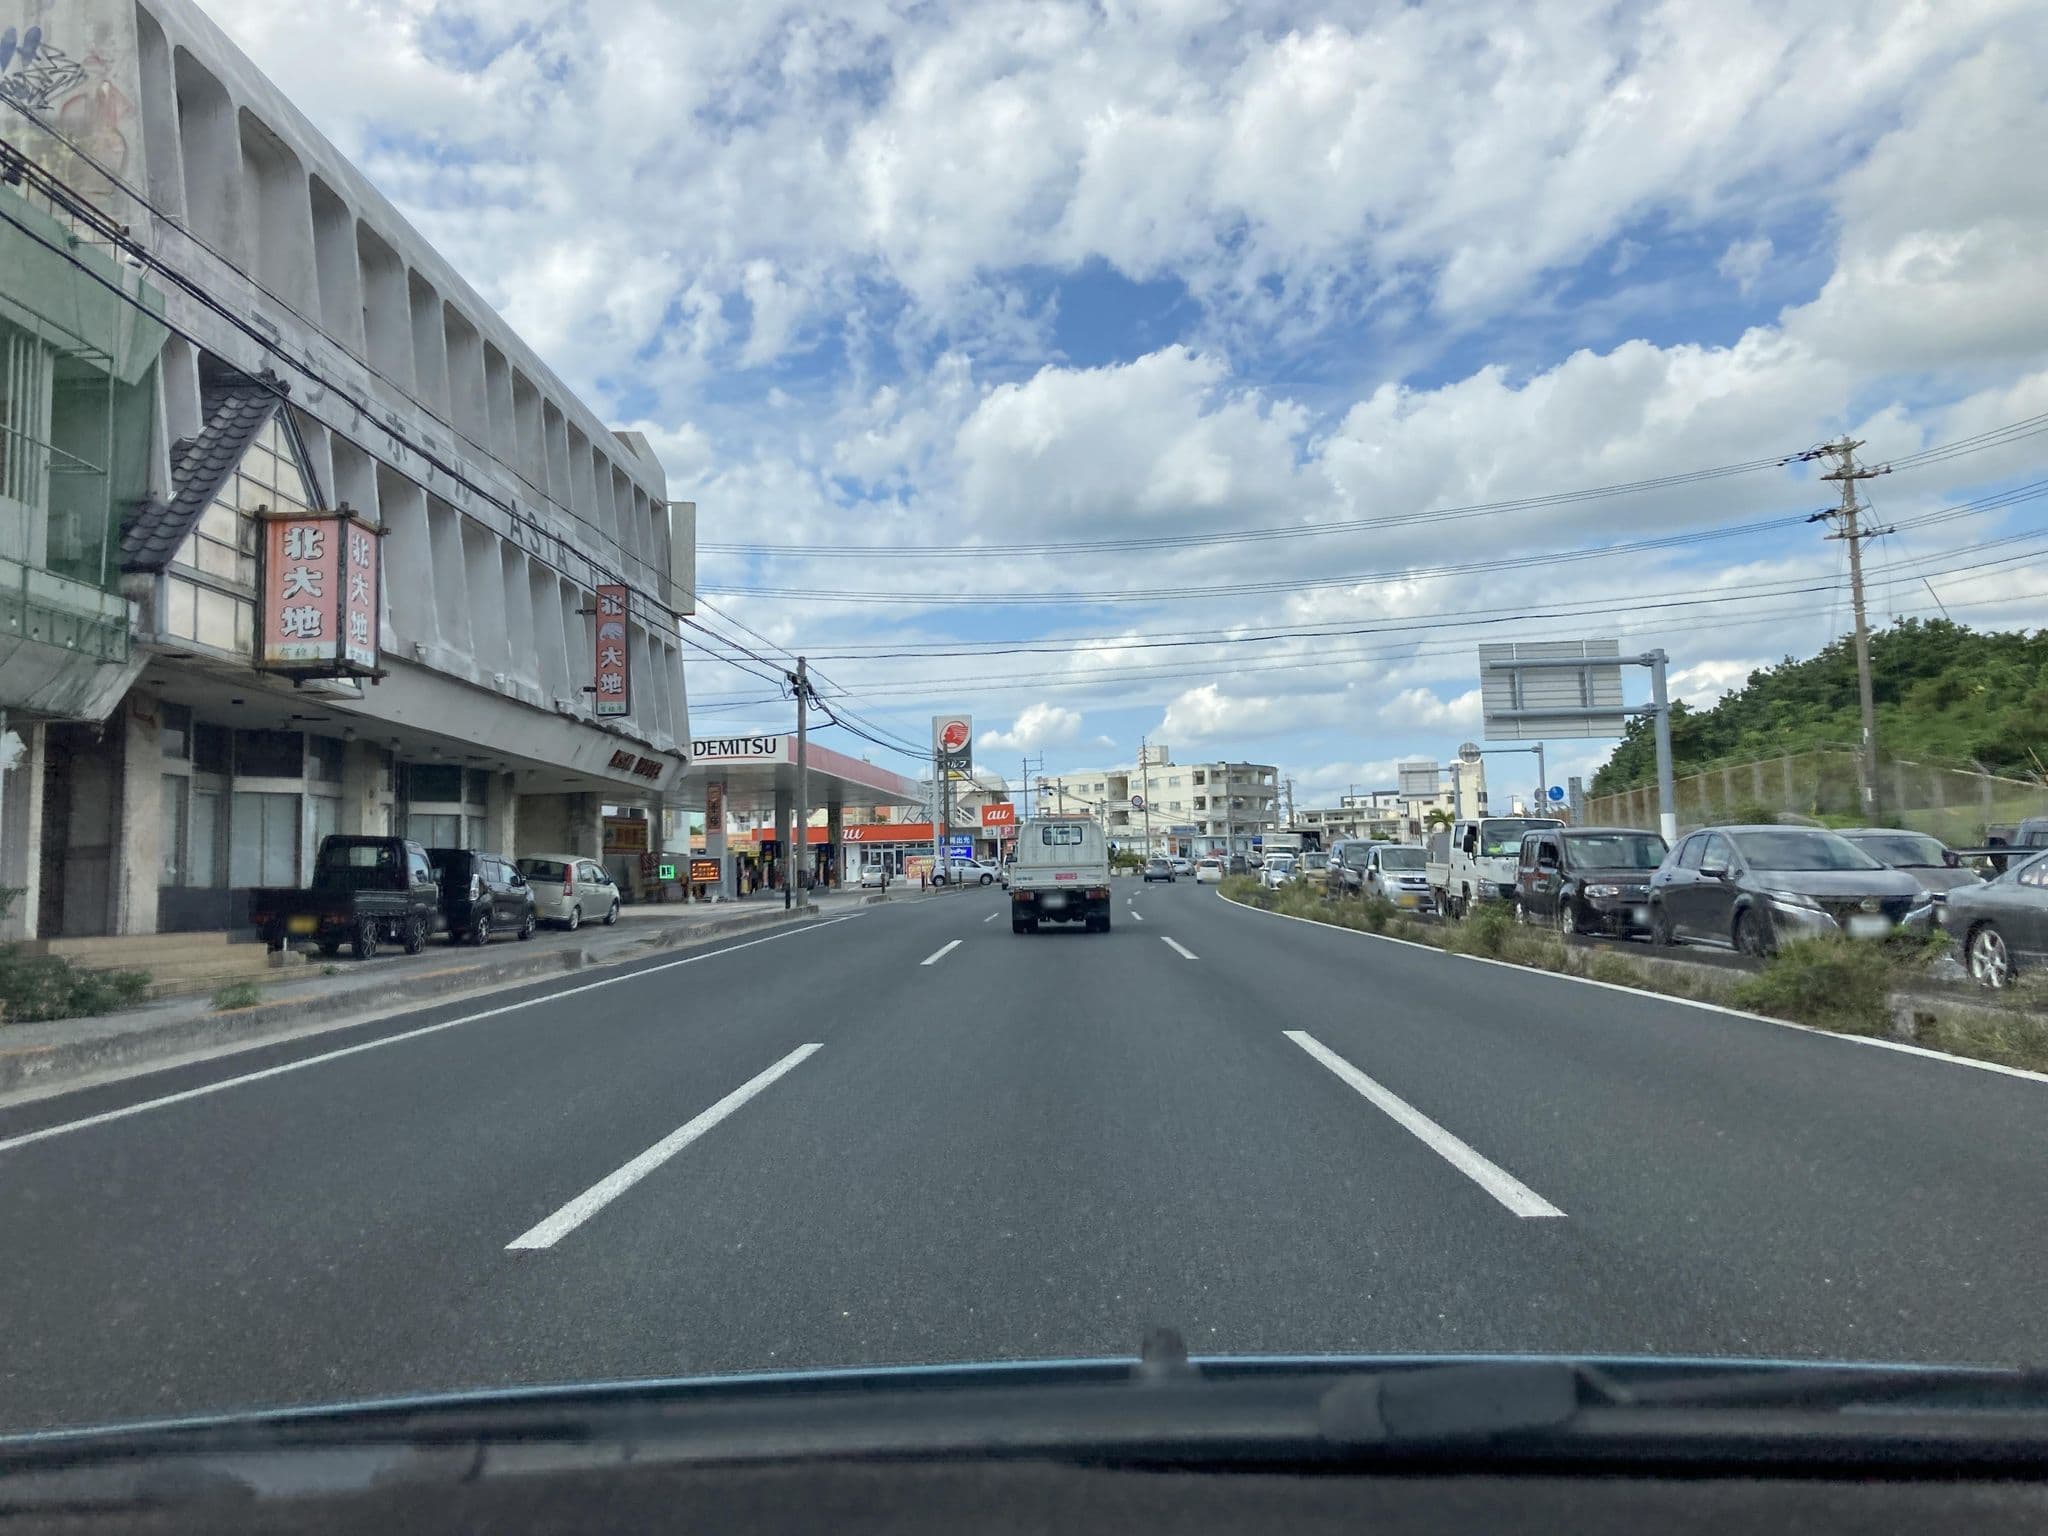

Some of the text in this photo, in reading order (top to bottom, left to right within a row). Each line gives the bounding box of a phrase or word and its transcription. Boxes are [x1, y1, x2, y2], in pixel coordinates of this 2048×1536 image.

[510, 499, 569, 573] ASIA
[280, 526, 325, 639] 北大地
[351, 533, 369, 645] 北大地
[600, 594, 623, 694] 北大地
[694, 738, 777, 756] DEMITSU
[987, 810, 1010, 820] au
